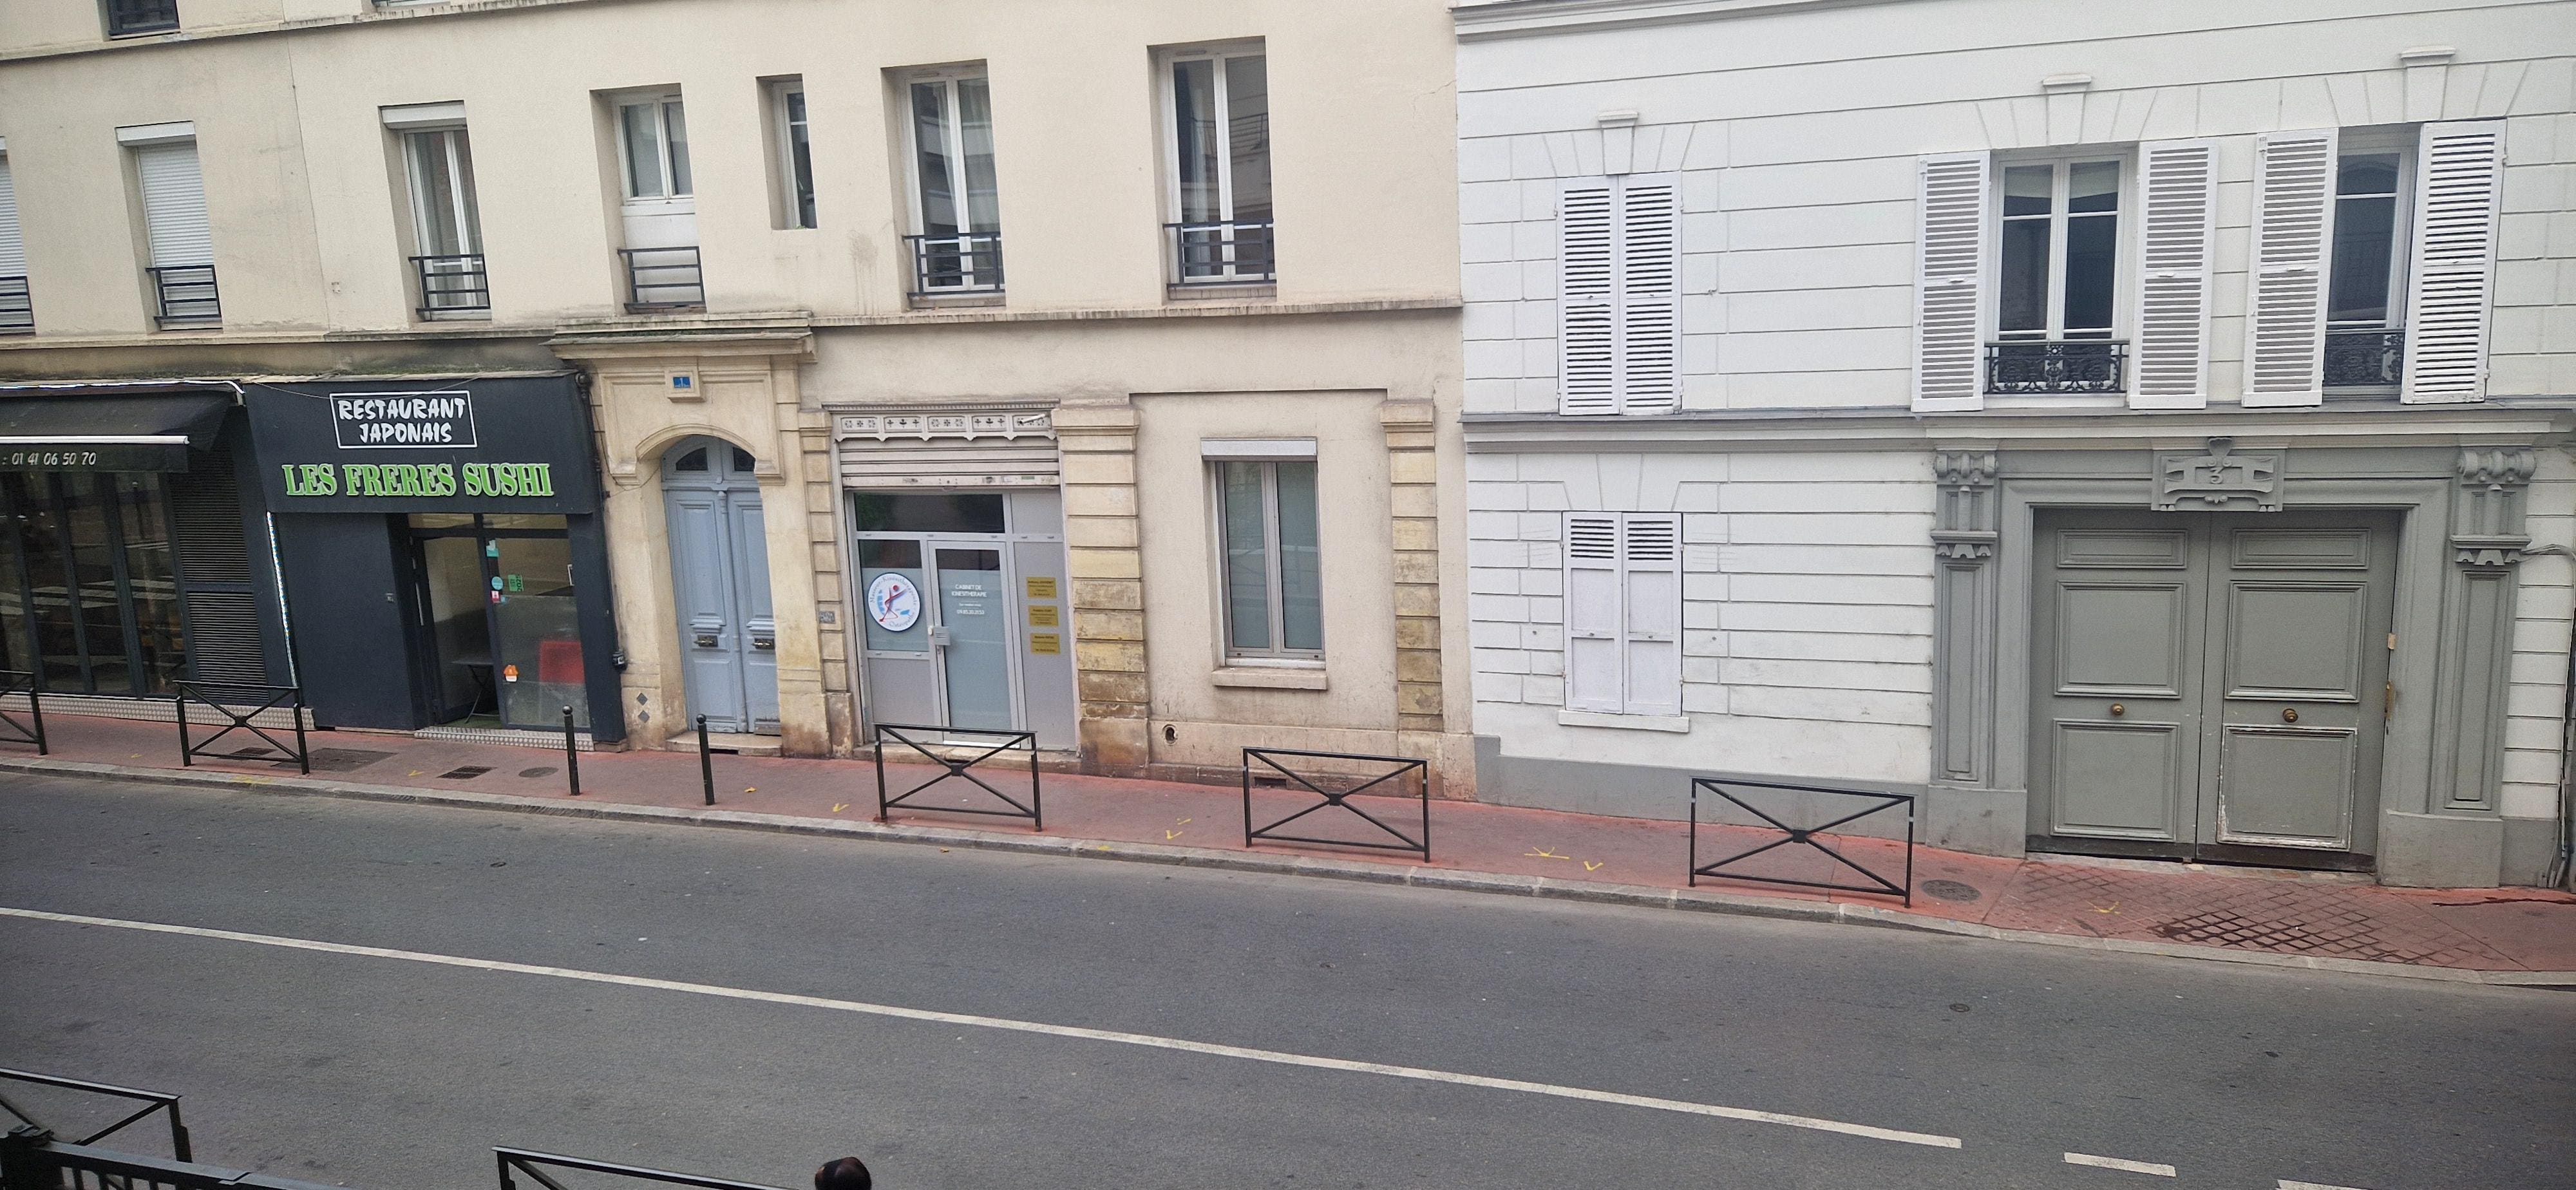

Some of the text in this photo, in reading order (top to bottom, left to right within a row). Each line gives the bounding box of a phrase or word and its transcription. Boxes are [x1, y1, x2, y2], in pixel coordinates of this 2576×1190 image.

[337, 398, 466, 420] RESTAURANT
[359, 422, 453, 443] JAPONAIS
[12, 452, 24, 465] 01
[27, 452, 39, 466] 41
[43, 452, 58, 466] 06
[62, 452, 77, 466] 50
[81, 451, 97, 466] 70
[281, 462, 554, 496] LES FRERES SUSHI
[2210, 466, 2224, 485] 3
